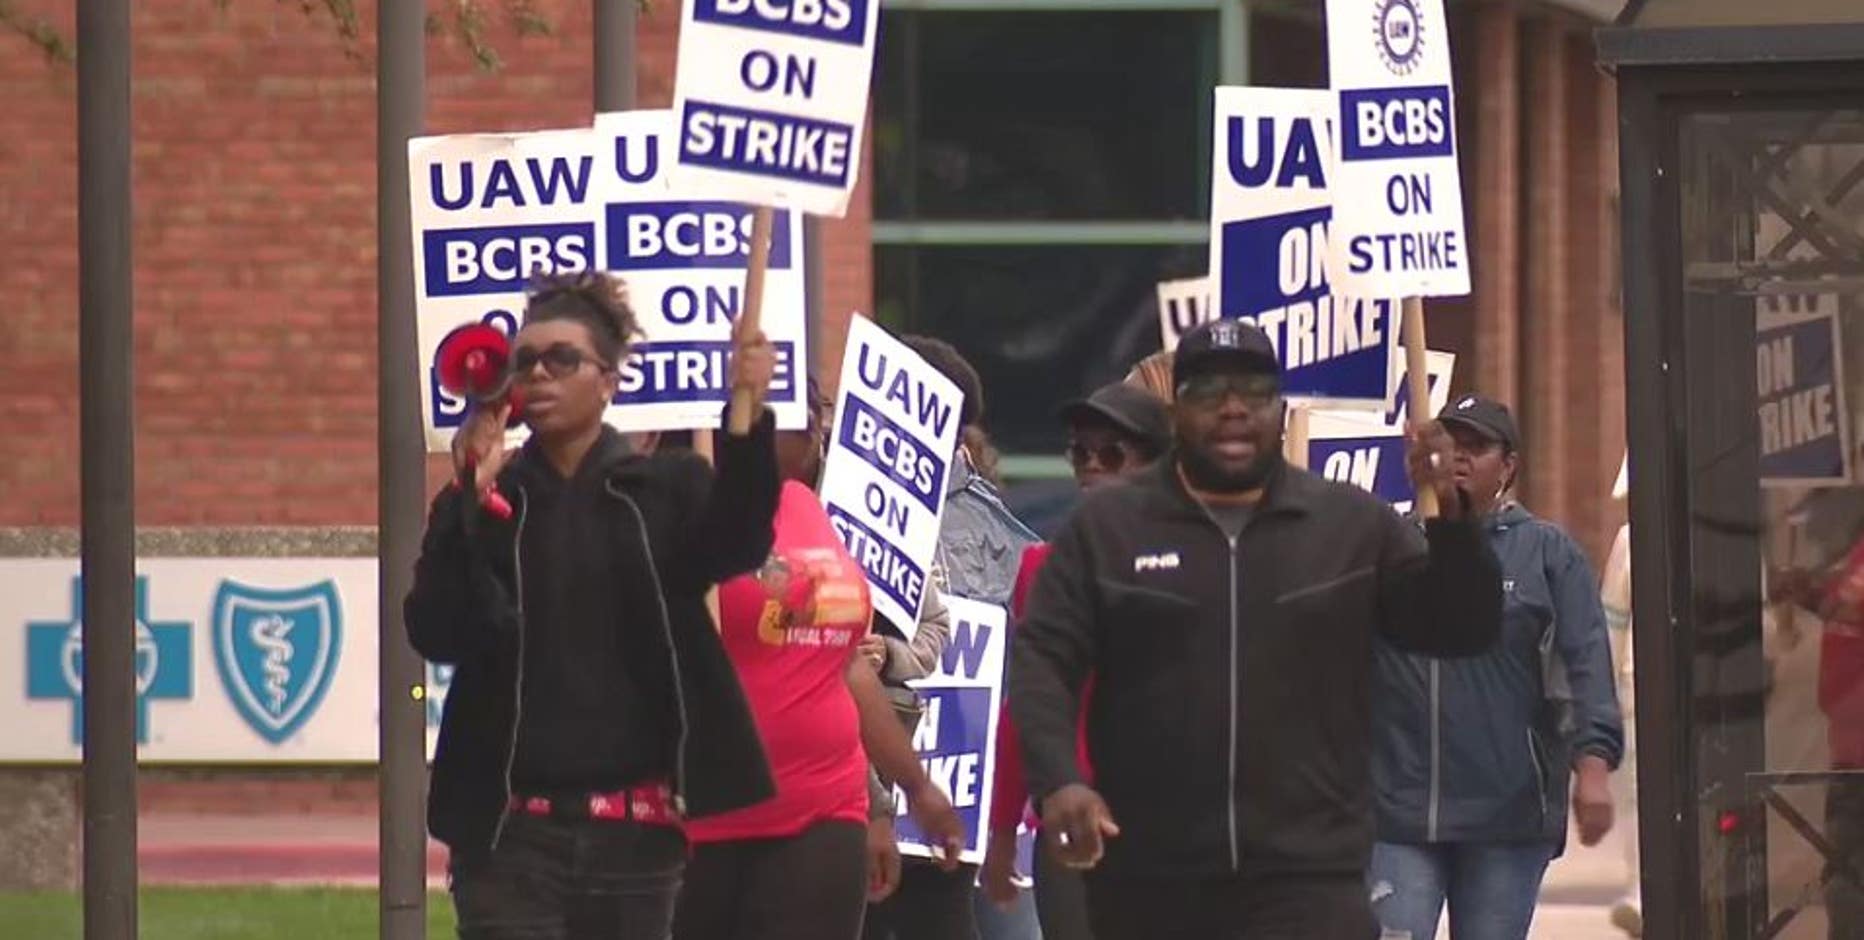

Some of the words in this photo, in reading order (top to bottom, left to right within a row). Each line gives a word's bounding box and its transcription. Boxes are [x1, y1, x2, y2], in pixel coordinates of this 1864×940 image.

[716, 0, 852, 30] BS
[740, 49, 816, 99] ON
[685, 111, 848, 176] STRIKE
[1357, 98, 1445, 147] BCBS
[1227, 116, 1333, 189] UA
[430, 156, 594, 210] UAW
[1386, 174, 1433, 214] ON
[446, 235, 587, 284] BCBS
[1348, 230, 1458, 274] STRIKE
[661, 285, 738, 325] ON
[1238, 293, 1381, 370] TRIKE
[618, 351, 789, 393] STRIE
[858, 342, 951, 439] UAW
[1759, 384, 1834, 454] RIKE
[853, 408, 934, 496] BCBS
[1323, 447, 1380, 493] ON
[864, 482, 909, 537] ON
[912, 696, 942, 752] N
